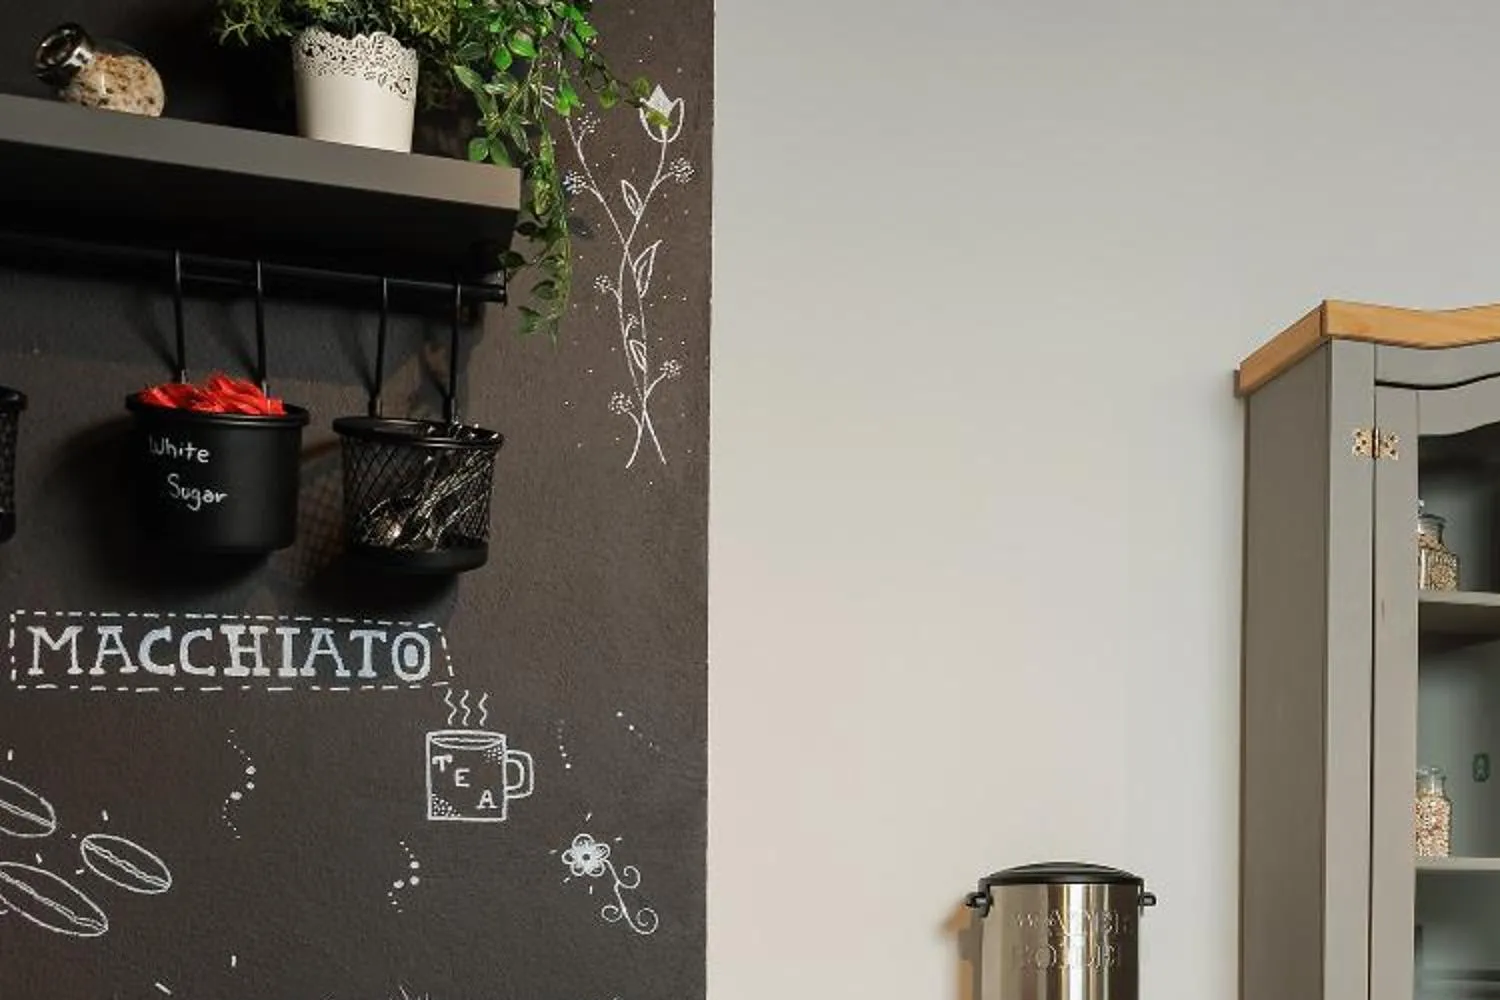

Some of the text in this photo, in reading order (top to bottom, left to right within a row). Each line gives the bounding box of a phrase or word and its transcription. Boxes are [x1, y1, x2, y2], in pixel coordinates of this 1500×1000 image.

[148, 434, 210, 463] White
[167, 473, 229, 511] Sugar
[26, 624, 432, 682] MACCHIATO
